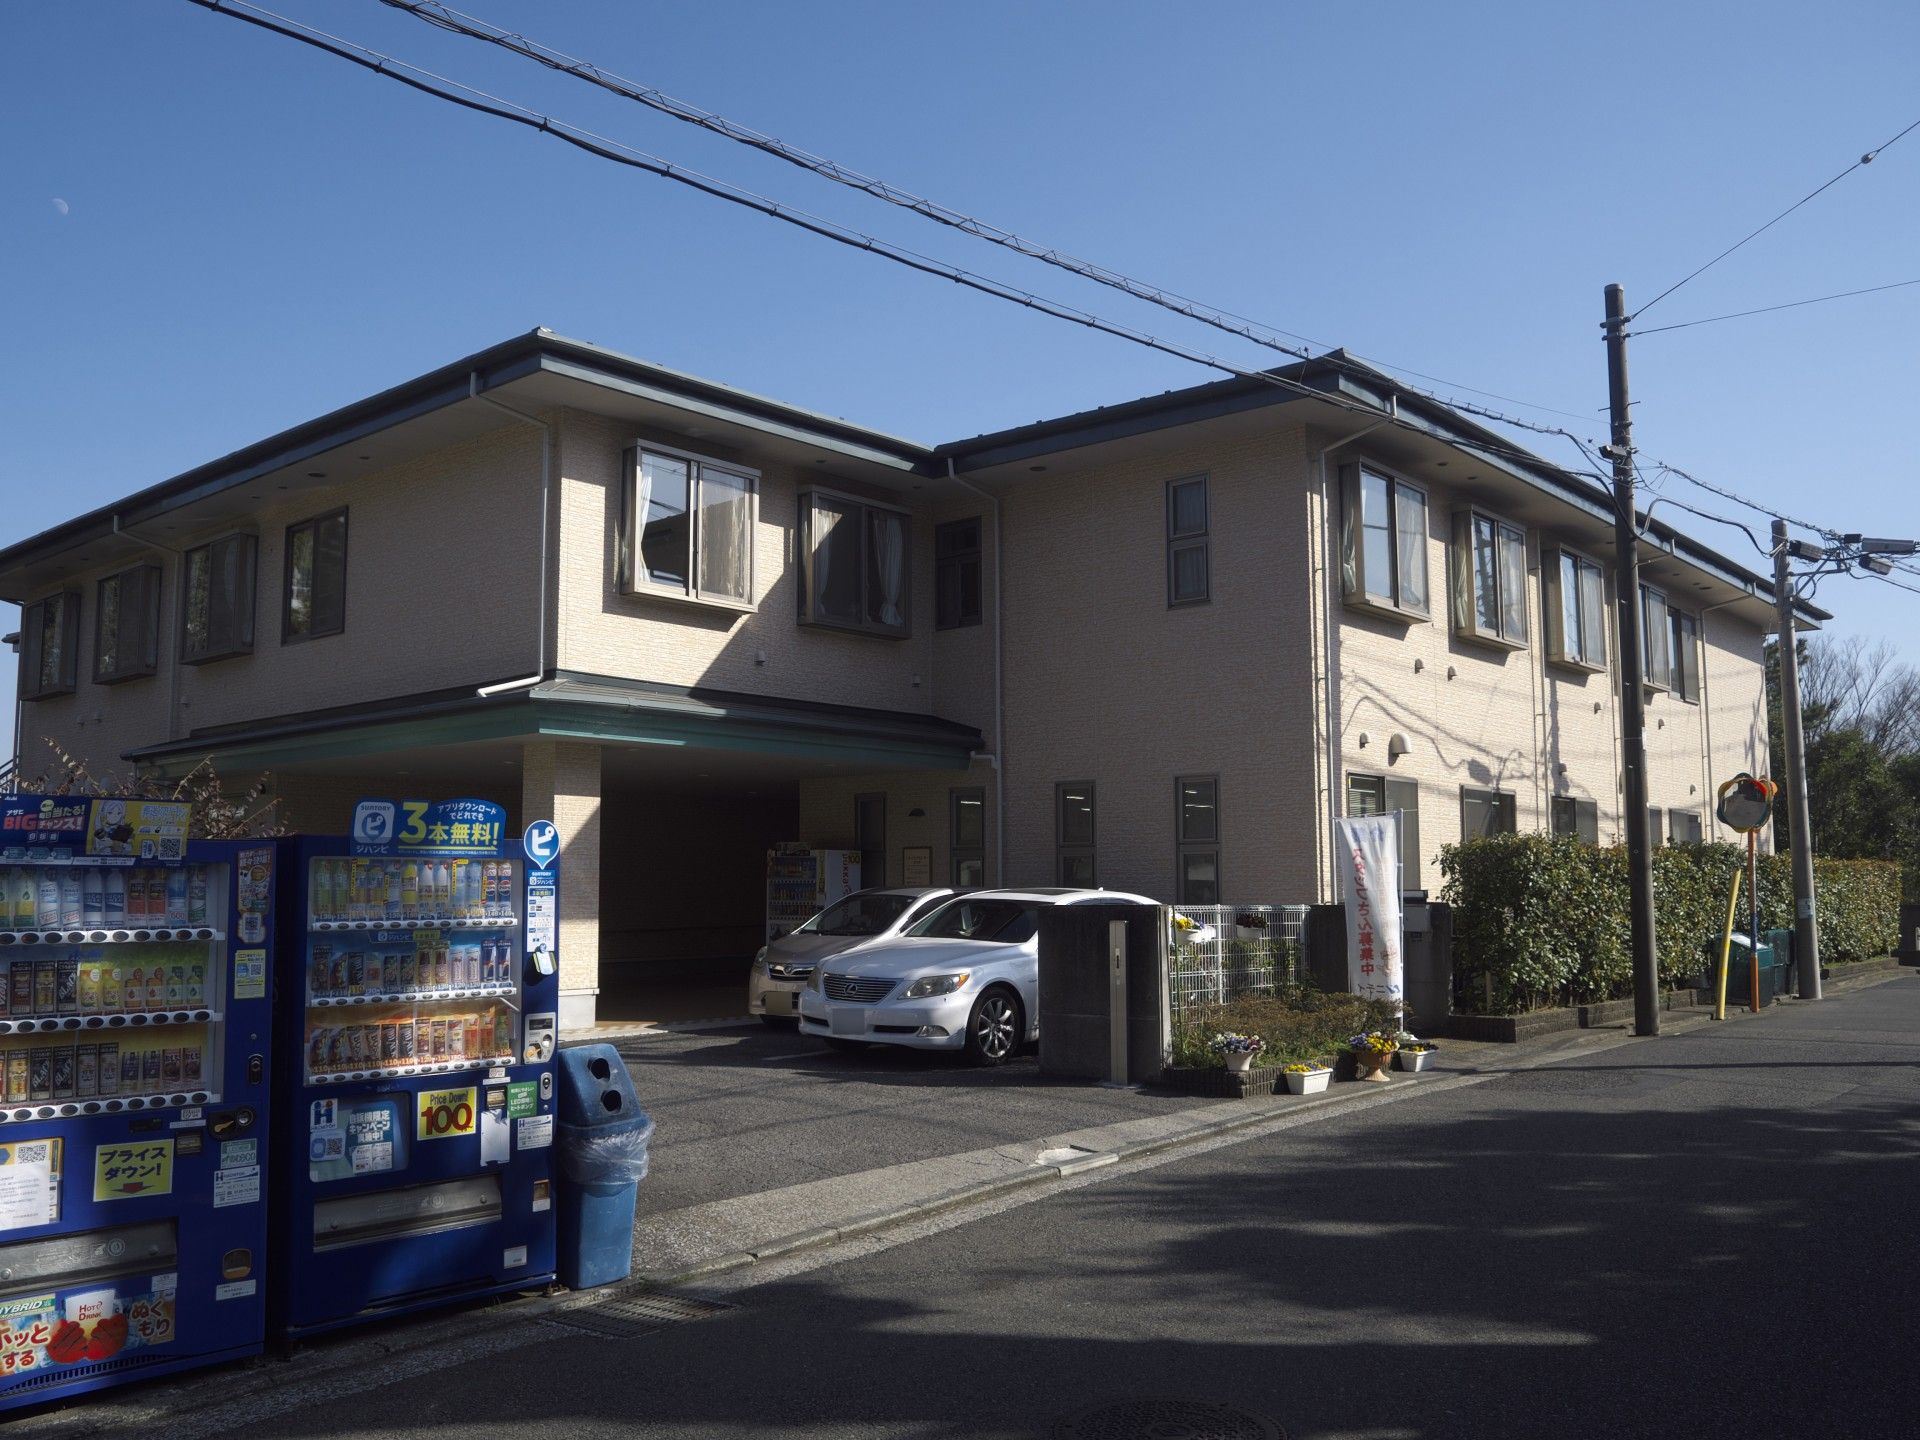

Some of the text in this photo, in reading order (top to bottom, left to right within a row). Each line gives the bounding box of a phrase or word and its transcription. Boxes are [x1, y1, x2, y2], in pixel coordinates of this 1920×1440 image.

[437, 801, 497, 816] アプリダウンロード
[450, 811, 484, 821] でどれでも
[3, 814, 38, 831] BIG
[421, 1103, 473, 1135] 100
[100, 1147, 167, 1164] プライス
[105, 1163, 161, 1181] ダウン!
[2, 1349, 34, 1369] する
